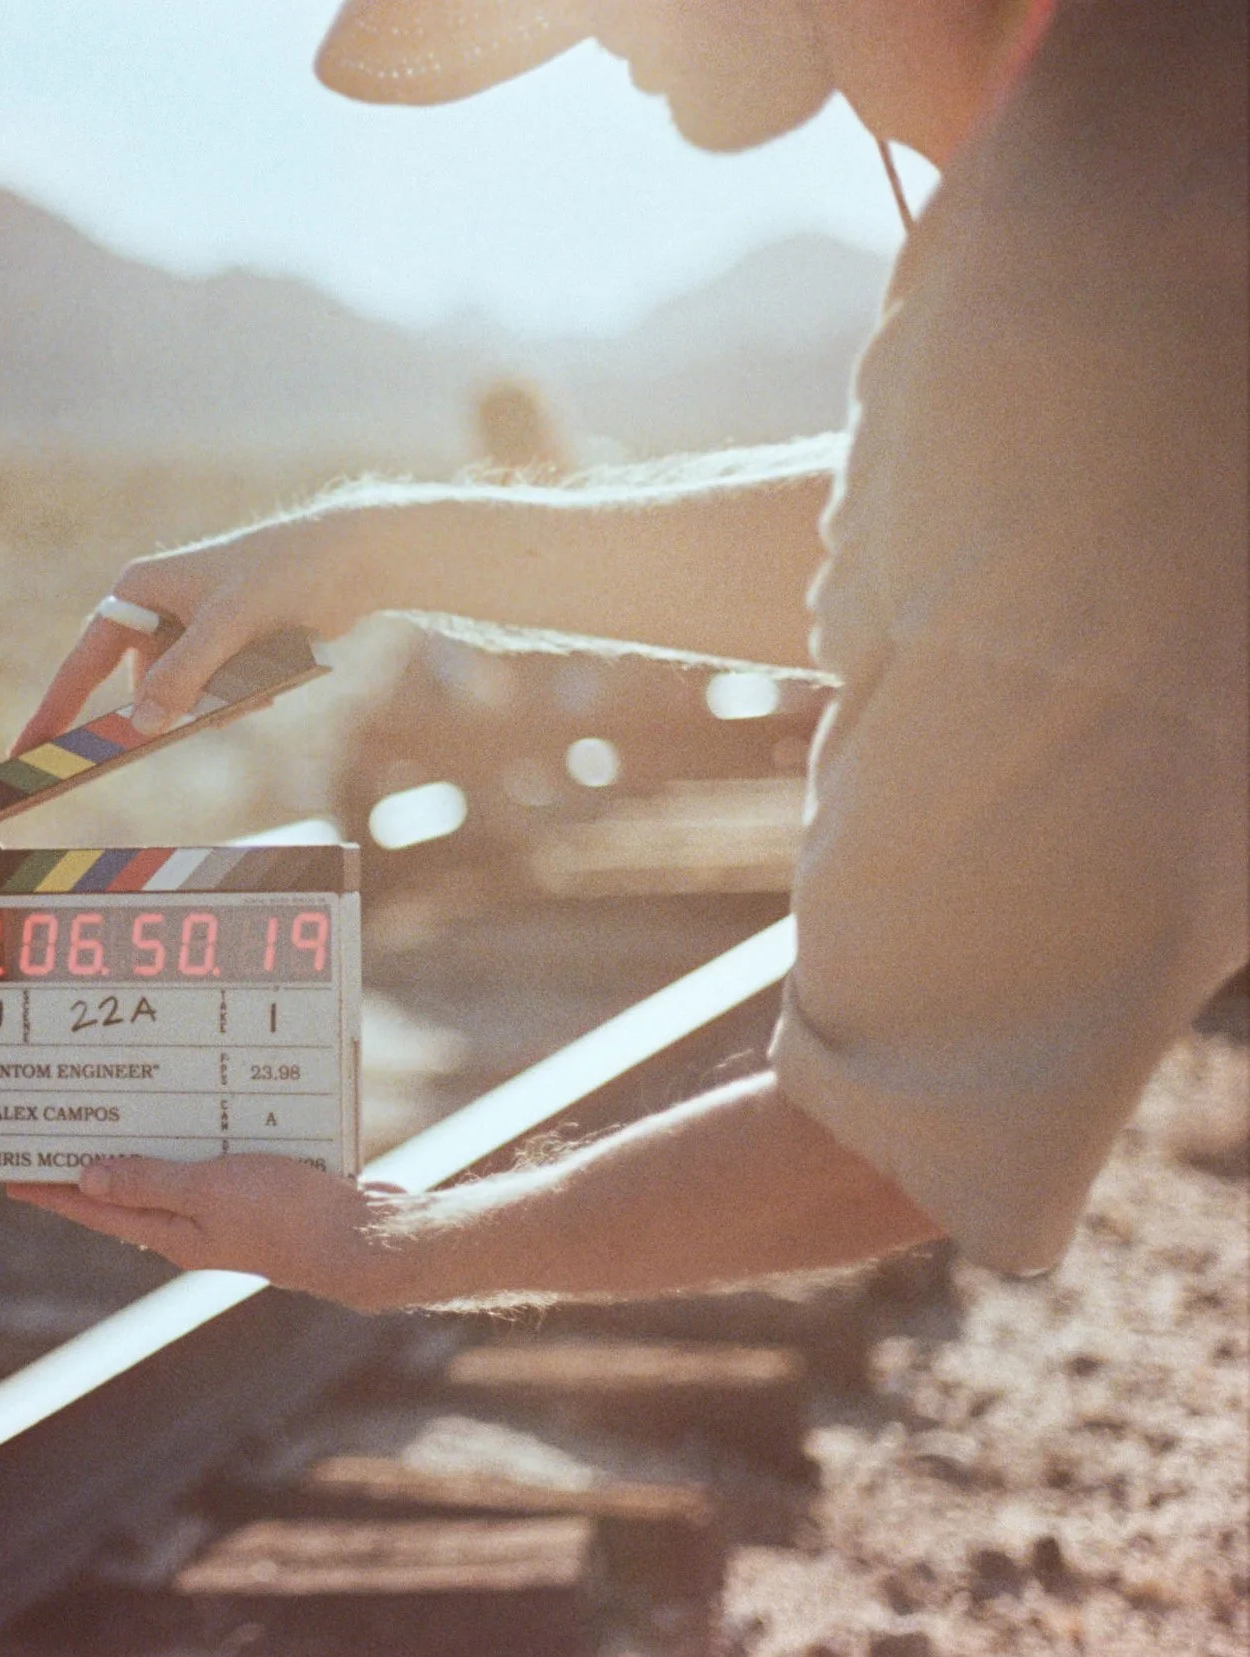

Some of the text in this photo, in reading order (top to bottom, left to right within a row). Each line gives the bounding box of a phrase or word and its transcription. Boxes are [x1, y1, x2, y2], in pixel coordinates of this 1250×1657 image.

[219, 990, 227, 1033] TAKE
[57, 1063, 160, 1079] ENGINEER"
[250, 1064, 301, 1081] 23.98
[43, 1106, 121, 1122] CAMPOS
[220, 1100, 229, 1131] CAM
[265, 1112, 277, 1126] A
[37, 1152, 143, 1168] MCDO
